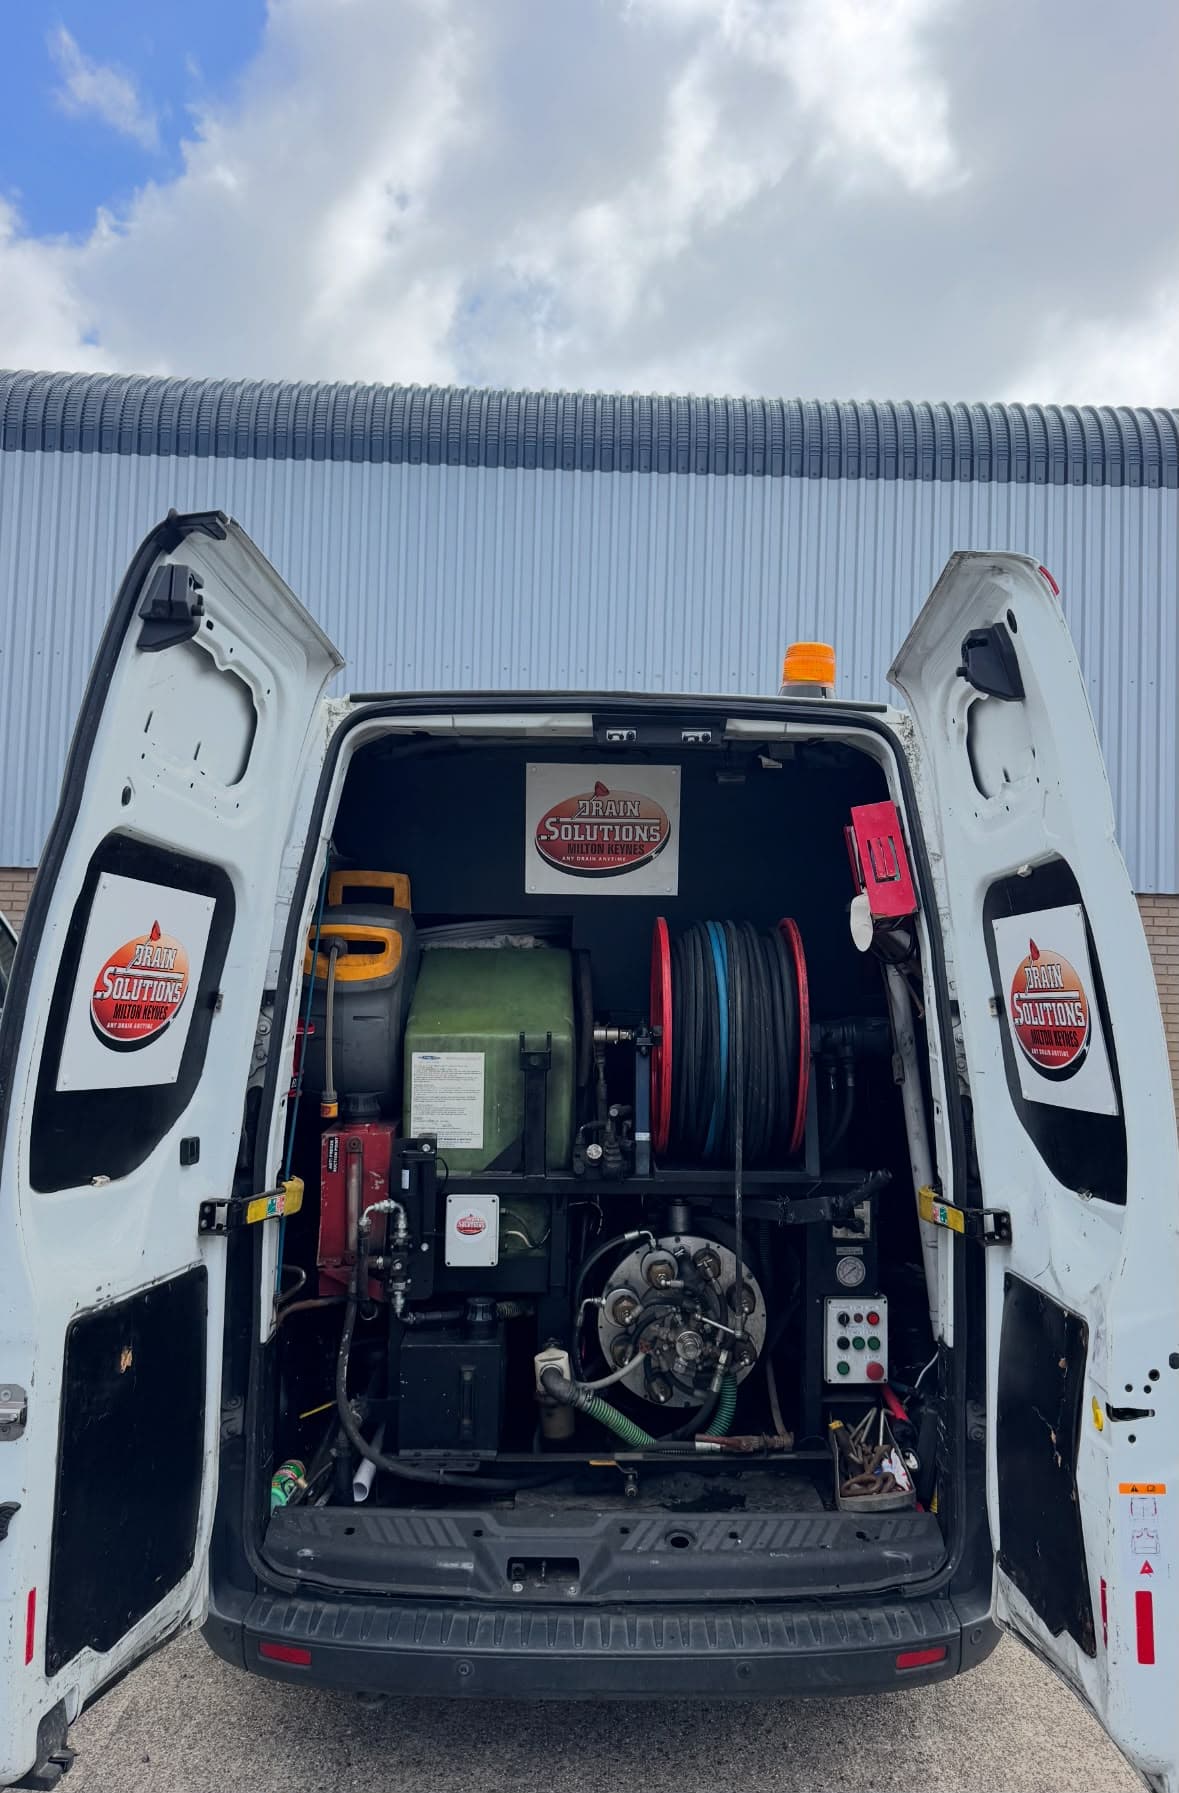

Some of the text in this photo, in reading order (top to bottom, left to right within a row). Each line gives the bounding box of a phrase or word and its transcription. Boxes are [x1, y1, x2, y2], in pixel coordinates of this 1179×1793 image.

[578, 799, 641, 817] DRAIN
[543, 816, 662, 842] SOLUTIONS
[567, 843, 645, 856] MILTON KEYNES
[134, 943, 178, 970] DRAIN
[99, 966, 184, 1003] SOLUTIONS
[1024, 963, 1064, 989] DRAIN
[113, 1002, 169, 1021] MILTON KEYNES
[1013, 991, 1087, 1027] SOLUTIONS
[1031, 1029, 1079, 1048] MILTON KEYNES
